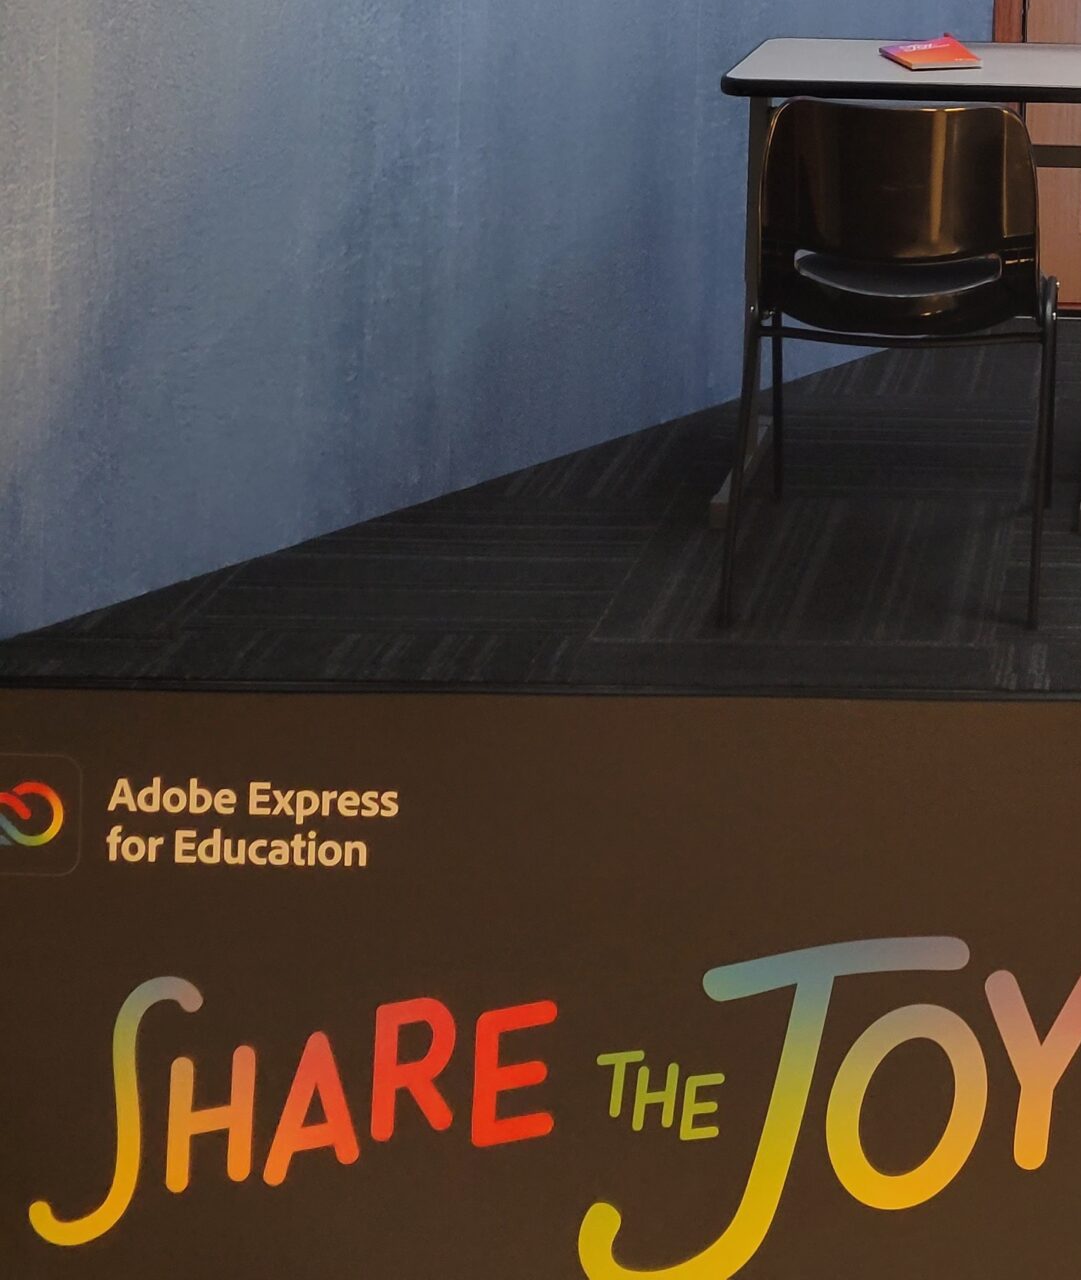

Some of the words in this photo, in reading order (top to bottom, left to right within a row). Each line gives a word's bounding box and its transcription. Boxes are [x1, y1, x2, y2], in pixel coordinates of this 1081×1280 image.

[107, 777, 237, 815] Adobe
[248, 781, 400, 824] Express
[106, 826, 164, 864] for
[173, 828, 367, 868] Education
[28, 975, 559, 1247] SHARE
[596, 1049, 726, 1141] THE
